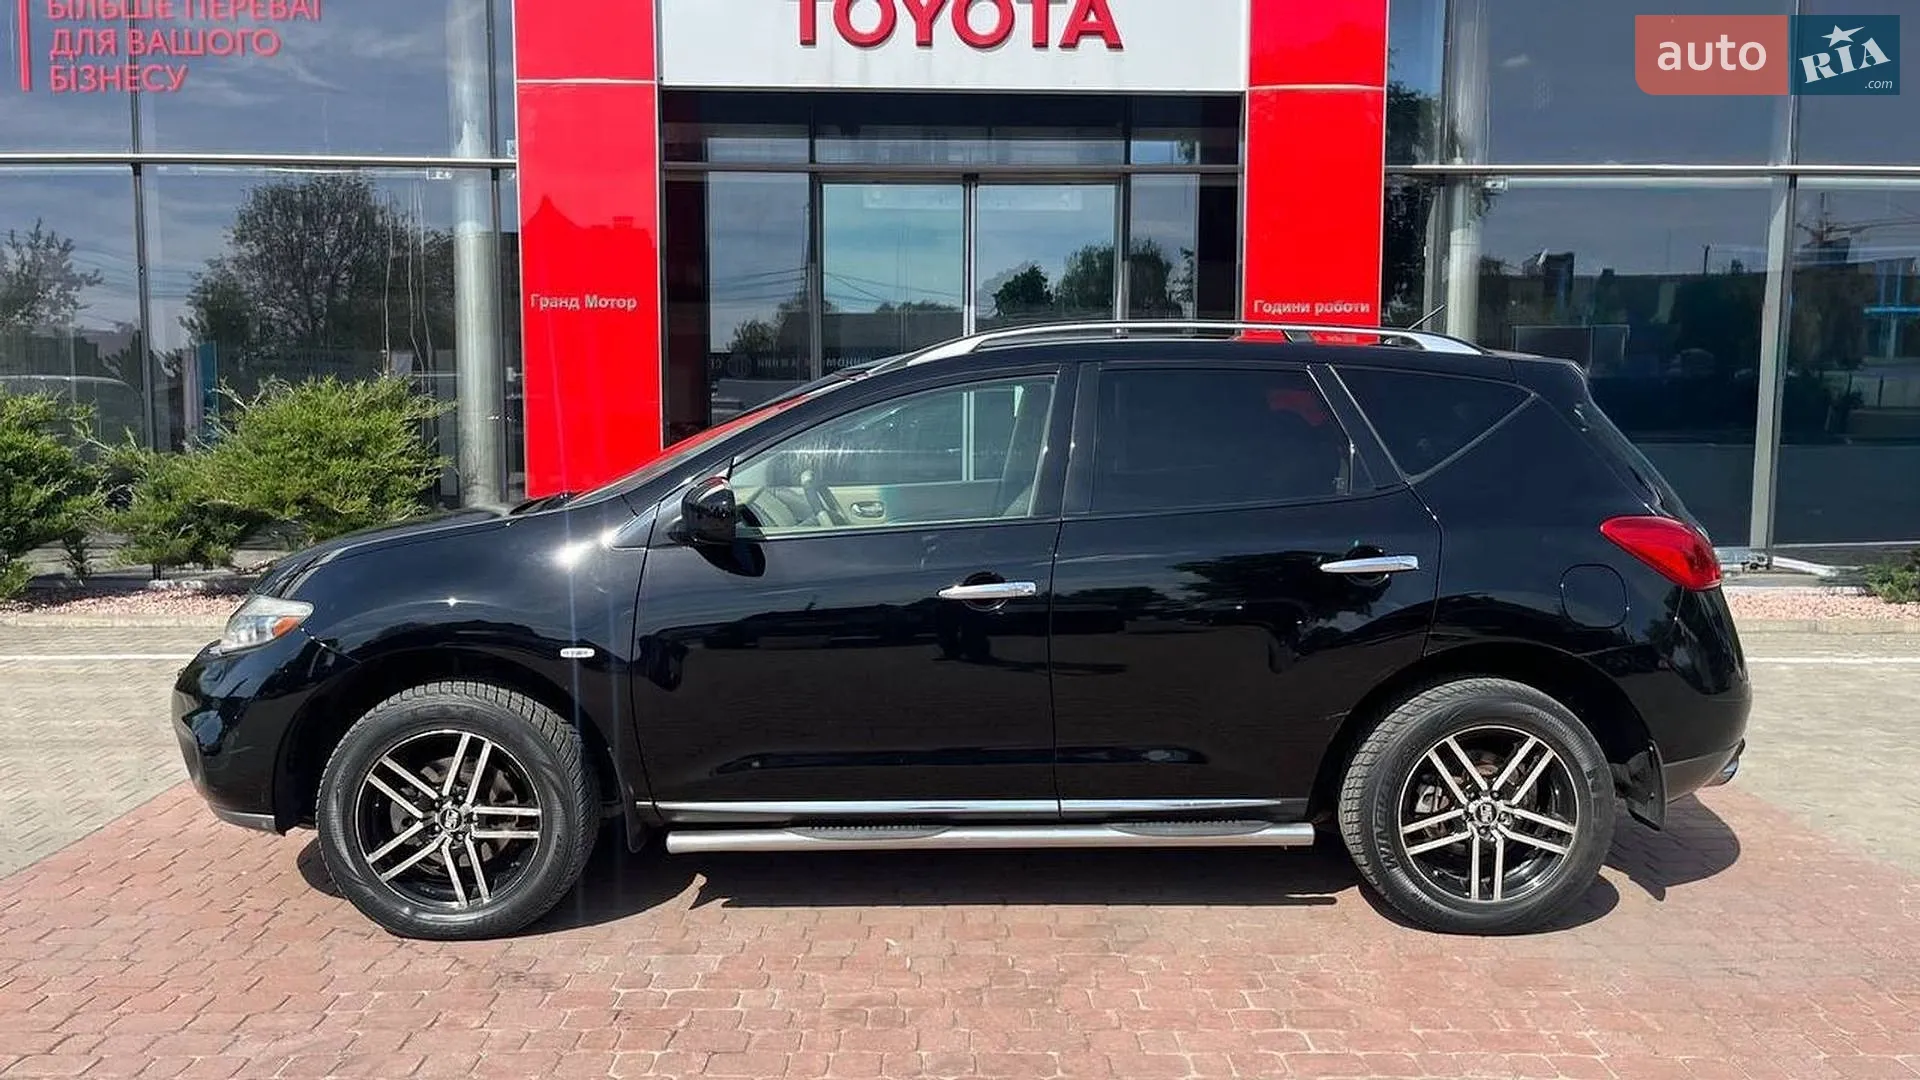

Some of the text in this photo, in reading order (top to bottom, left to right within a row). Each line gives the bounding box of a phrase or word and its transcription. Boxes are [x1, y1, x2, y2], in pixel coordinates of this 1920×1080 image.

[47, 0, 176, 20] БІЛЬШЕ
[795, 0, 1124, 50] TOYOTA
[50, 27, 282, 60] ДЛЯ ВАШОГО
[50, 64, 188, 92] БІЗНЕСУ
[530, 293, 638, 311] Гранд Мотор
[1254, 300, 1370, 316] Години роботи
